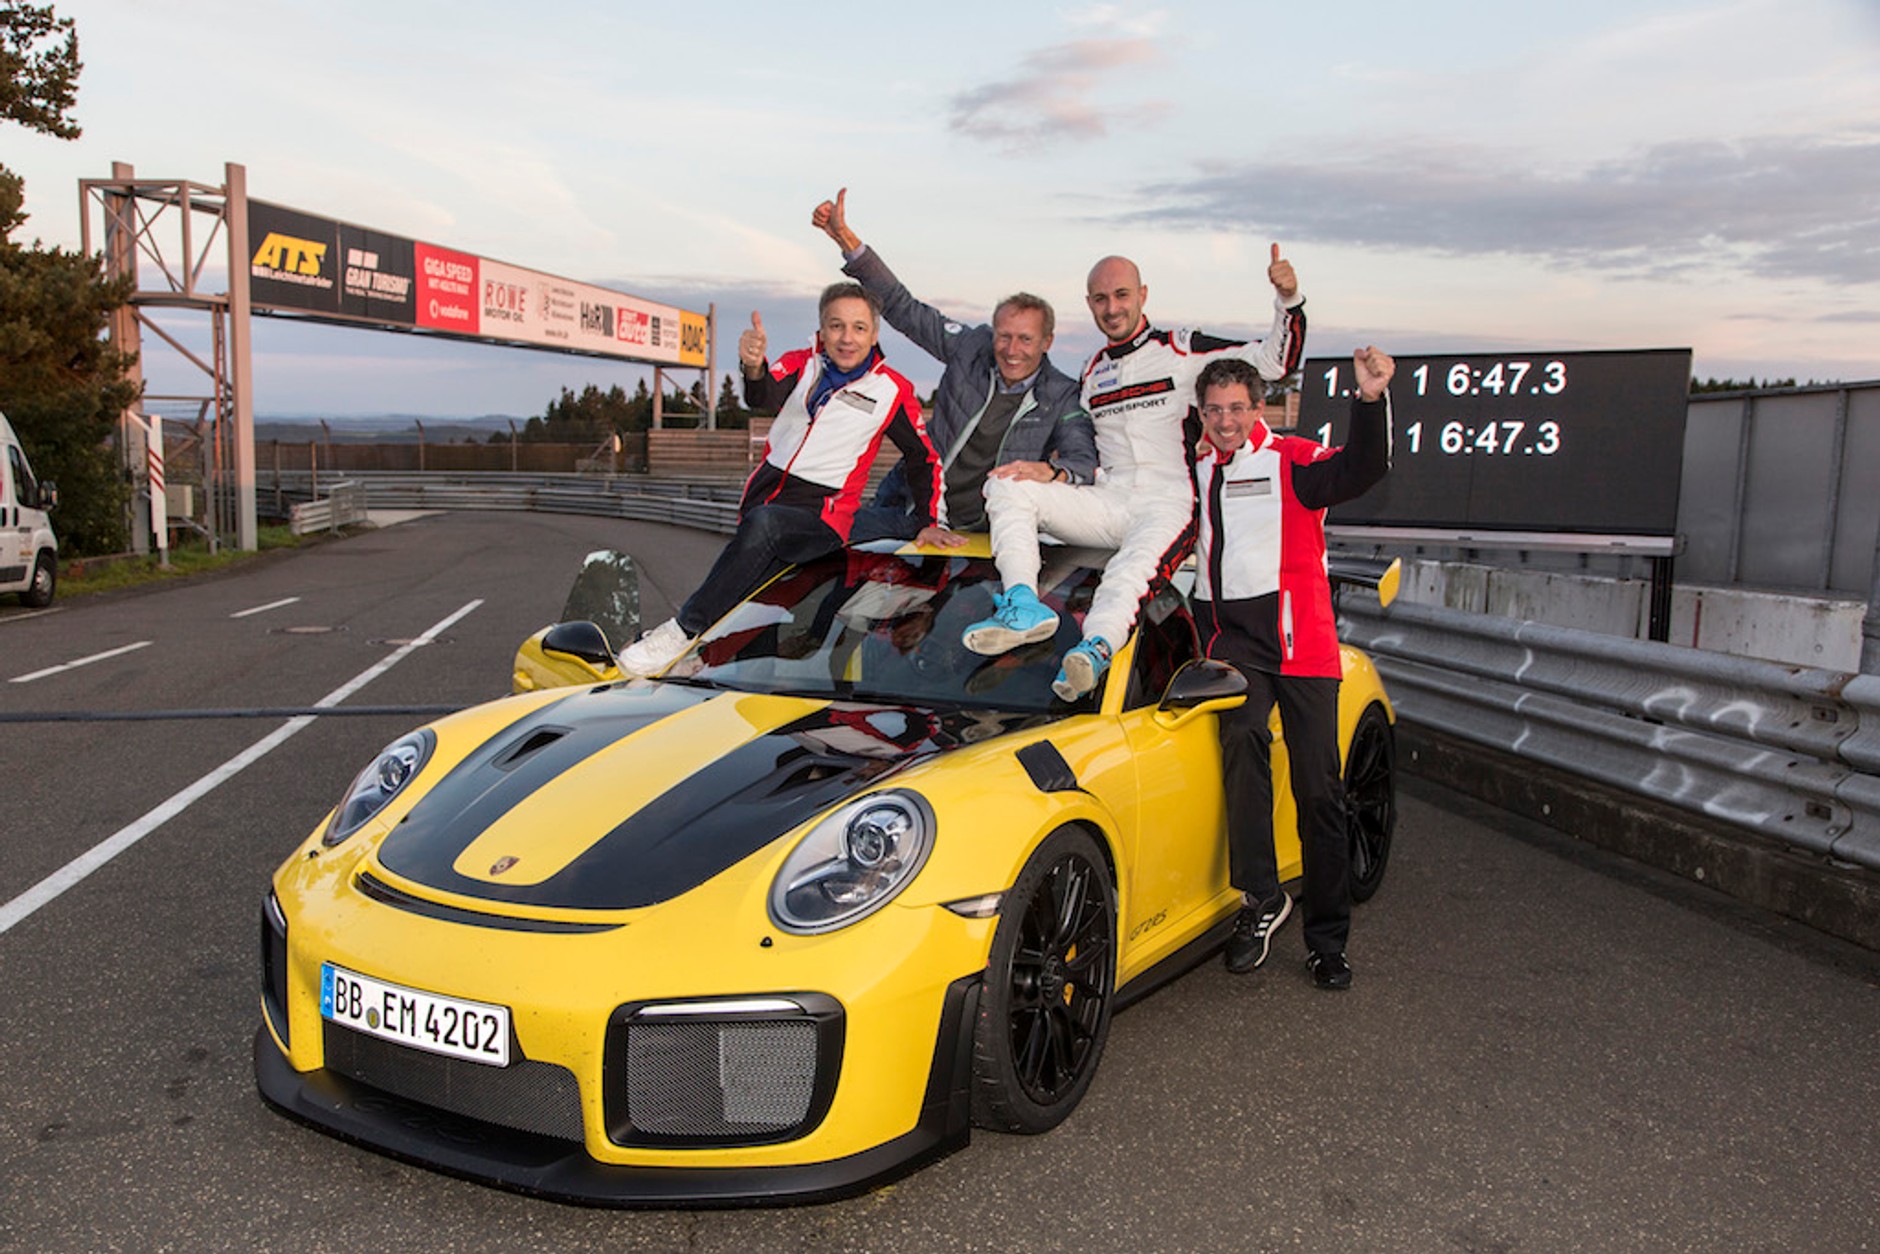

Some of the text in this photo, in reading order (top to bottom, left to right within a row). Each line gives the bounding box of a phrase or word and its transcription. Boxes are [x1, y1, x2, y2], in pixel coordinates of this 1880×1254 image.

[252, 232, 327, 277] ATS
[485, 281, 526, 312] ROWE
[484, 307, 525, 324] MOTOR OIL
[681, 322, 704, 354] ADAC
[1413, 365, 1428, 396] 1
[1447, 362, 1567, 396] 6:47.3
[1094, 397, 1167, 419] MOTORSPORT
[1407, 421, 1422, 453] 1
[1441, 421, 1560, 455] 6:47.3
[335, 976, 499, 1054] BB EM 4202
